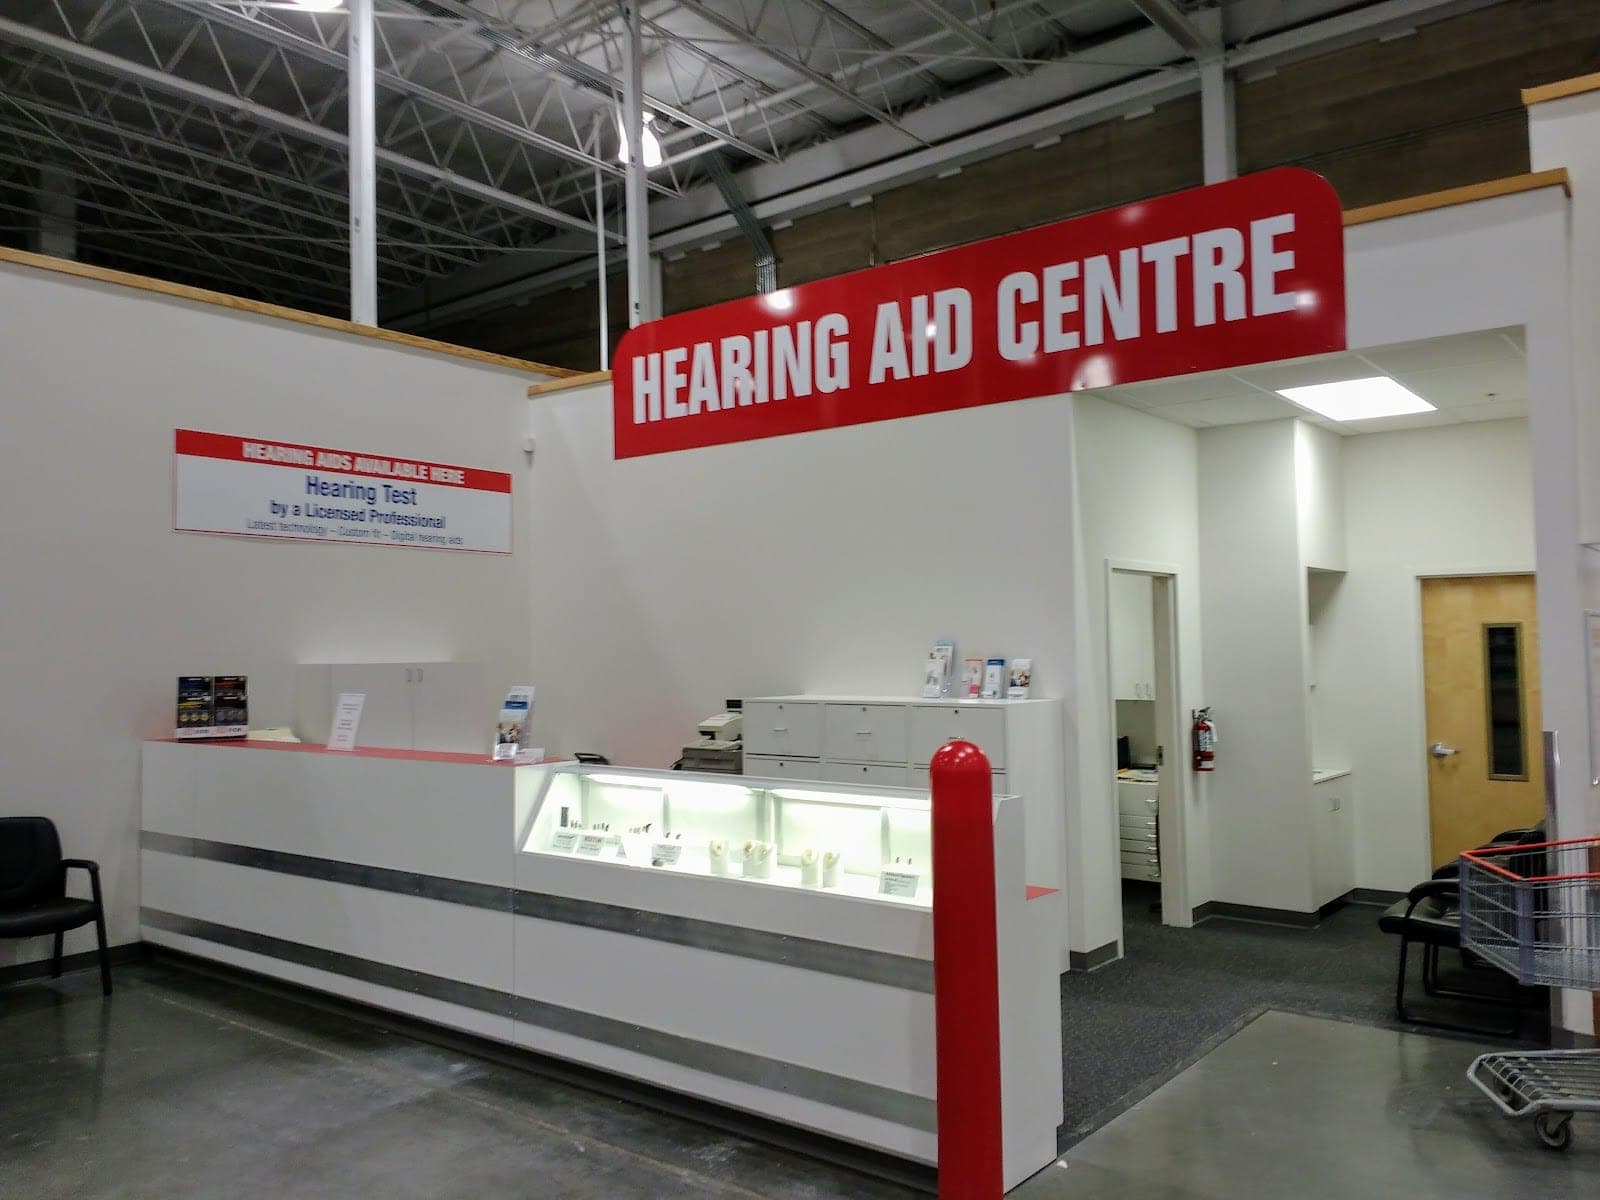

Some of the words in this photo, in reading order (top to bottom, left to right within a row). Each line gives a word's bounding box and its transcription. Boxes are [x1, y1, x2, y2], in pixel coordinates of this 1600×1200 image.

[632, 313, 850, 424] HEARING
[868, 287, 973, 385] AID
[997, 213, 1296, 362] CENTRE
[242, 441, 313, 466] HEARING
[315, 451, 352, 471] AIDS
[354, 456, 428, 480] AVAILABLE
[430, 465, 464, 485] HERE
[306, 475, 376, 505] Hearing
[383, 484, 417, 506] Test
[270, 499, 288, 518] by
[292, 504, 300, 516] a
[305, 502, 365, 522] Licensed
[369, 508, 446, 529] Professional
